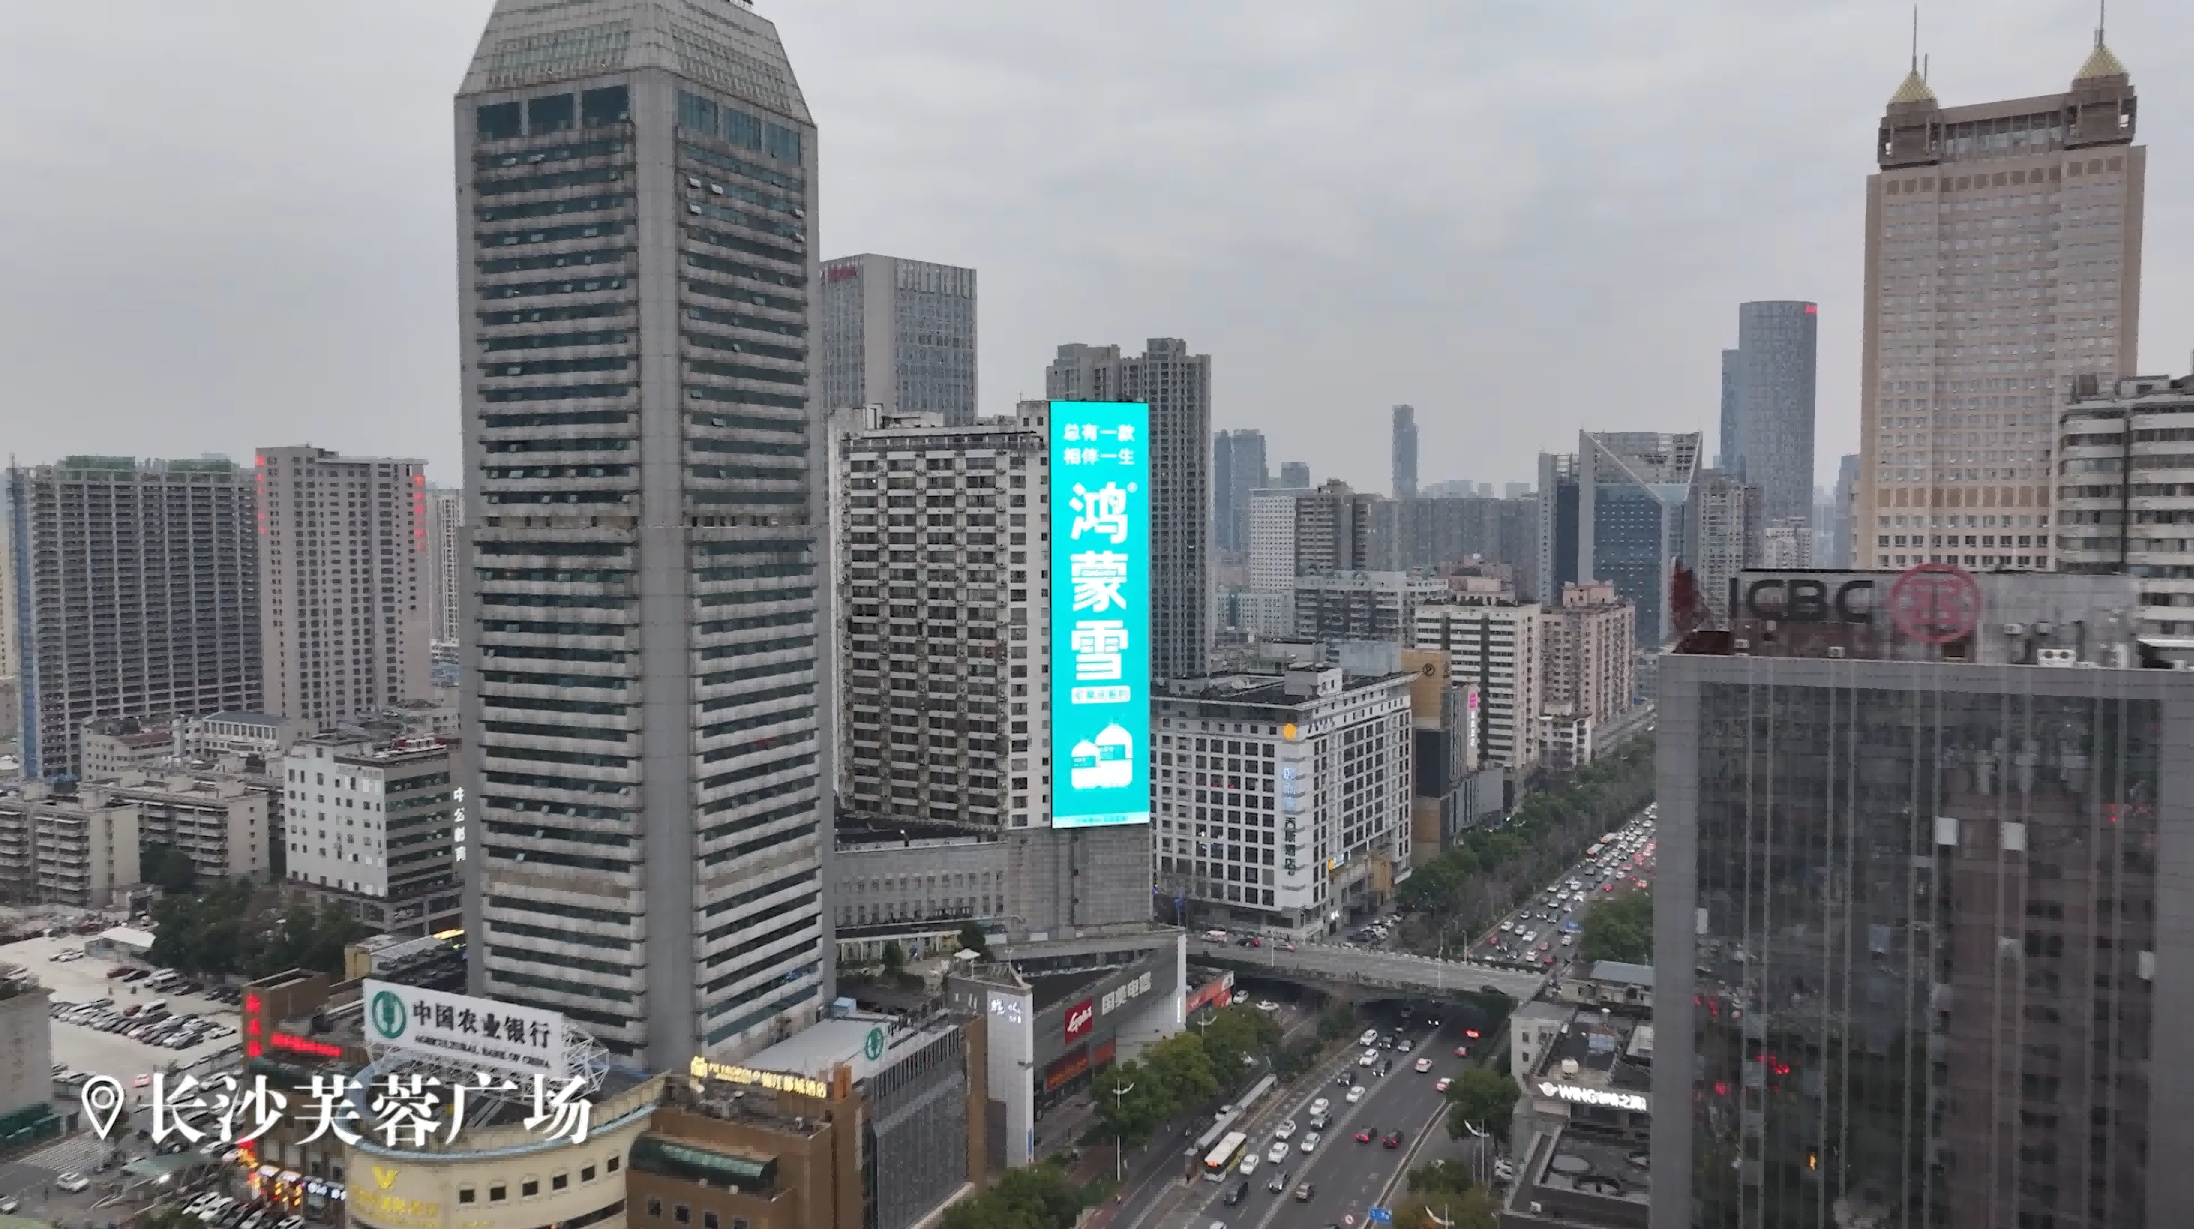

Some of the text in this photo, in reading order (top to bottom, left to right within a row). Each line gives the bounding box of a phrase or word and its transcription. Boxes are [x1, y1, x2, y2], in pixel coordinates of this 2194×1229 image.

[1064, 423, 1135, 442] 总有一款
[1064, 447, 1135, 465] 相伴一生
[1069, 482, 1128, 680] 鸿蒙雪
[1729, 577, 1875, 624] ICBC
[1102, 971, 1151, 1016] 国美电器
[413, 999, 550, 1049] 中国农业银行
